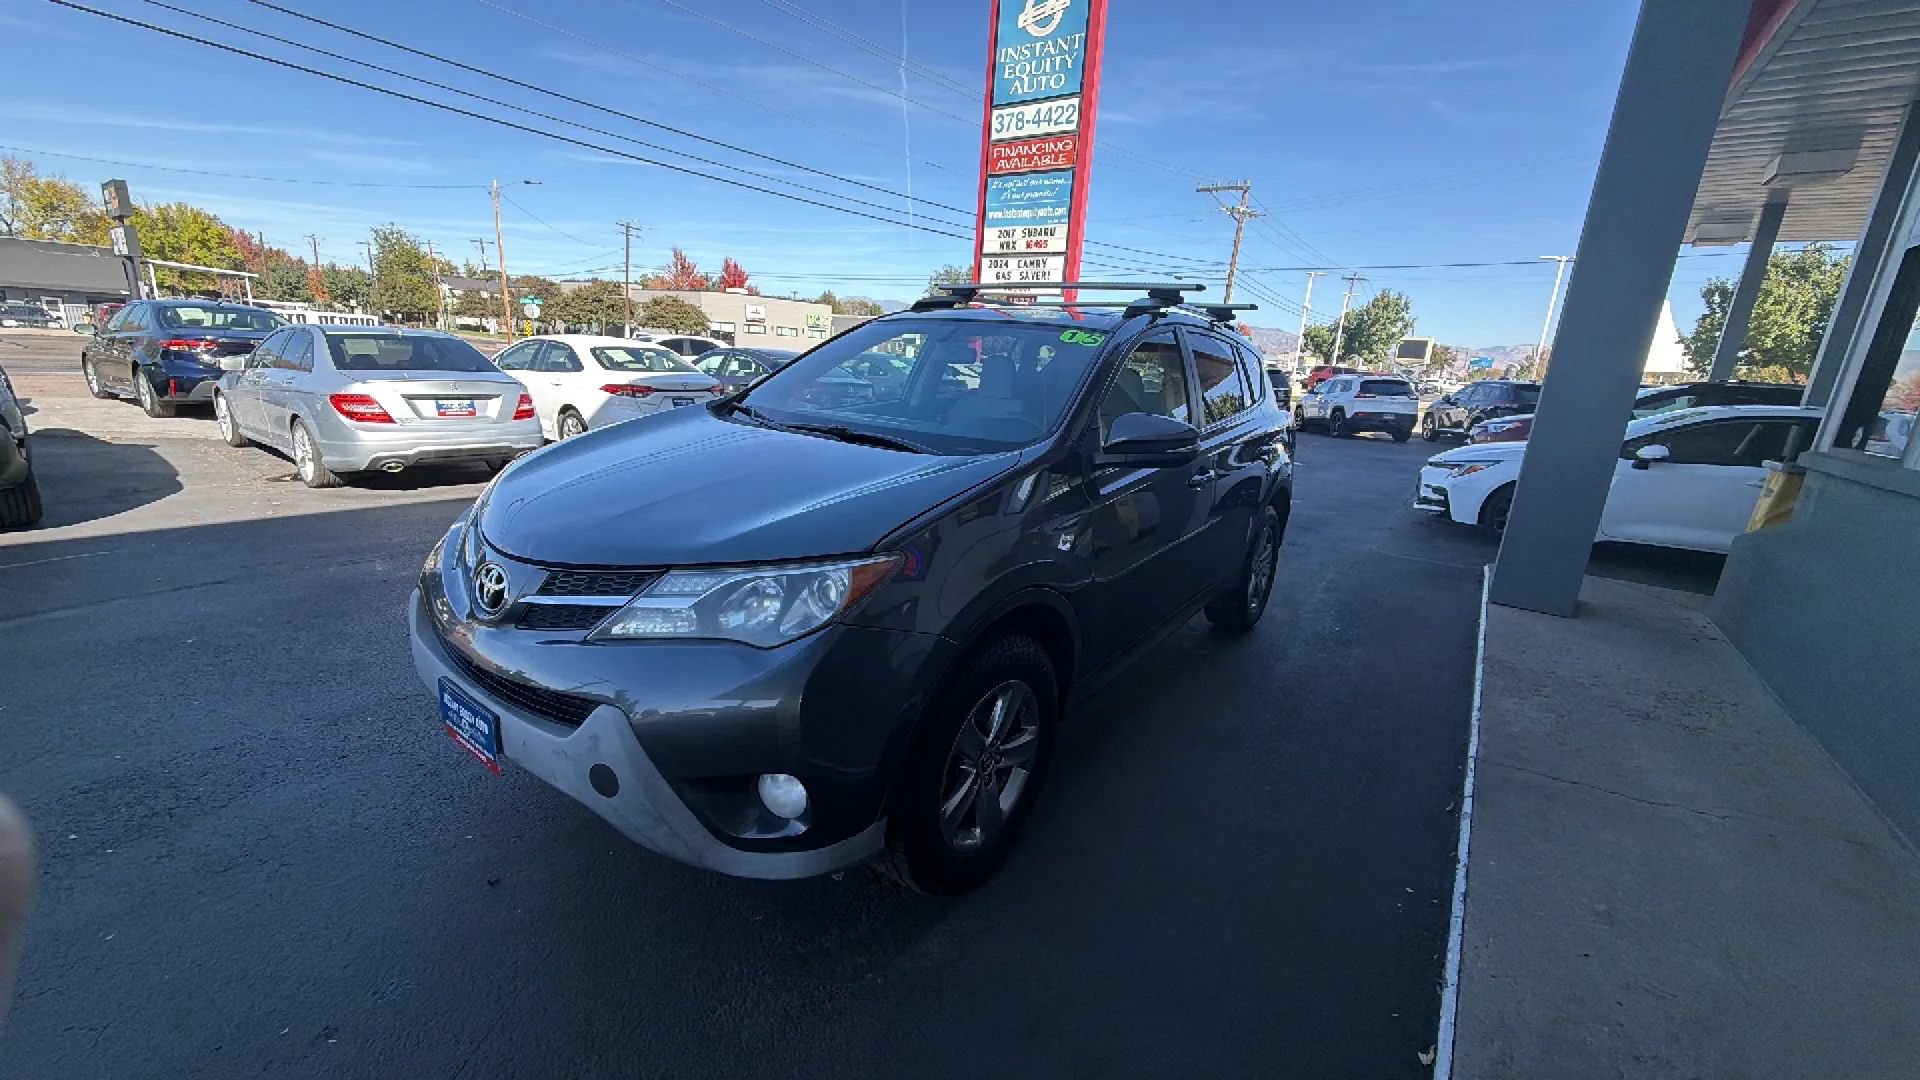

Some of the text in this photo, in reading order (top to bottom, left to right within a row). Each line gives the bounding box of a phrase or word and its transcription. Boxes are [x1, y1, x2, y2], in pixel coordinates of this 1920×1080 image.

[1000, 33, 1085, 63] INSTANT
[1003, 52, 1078, 79] EQUITY
[1009, 73, 1066, 95] AUTO
[994, 103, 1077, 134] 378-4422
[993, 140, 1073, 159] FINANCING
[995, 153, 1068, 171] AVAILABLE
[997, 227, 1057, 239] 2017 SUBARU
[999, 240, 1017, 250] WRX
[988, 257, 1048, 269] 2024 CAMRY
[995, 270, 1051, 281] GAS SAVER!
